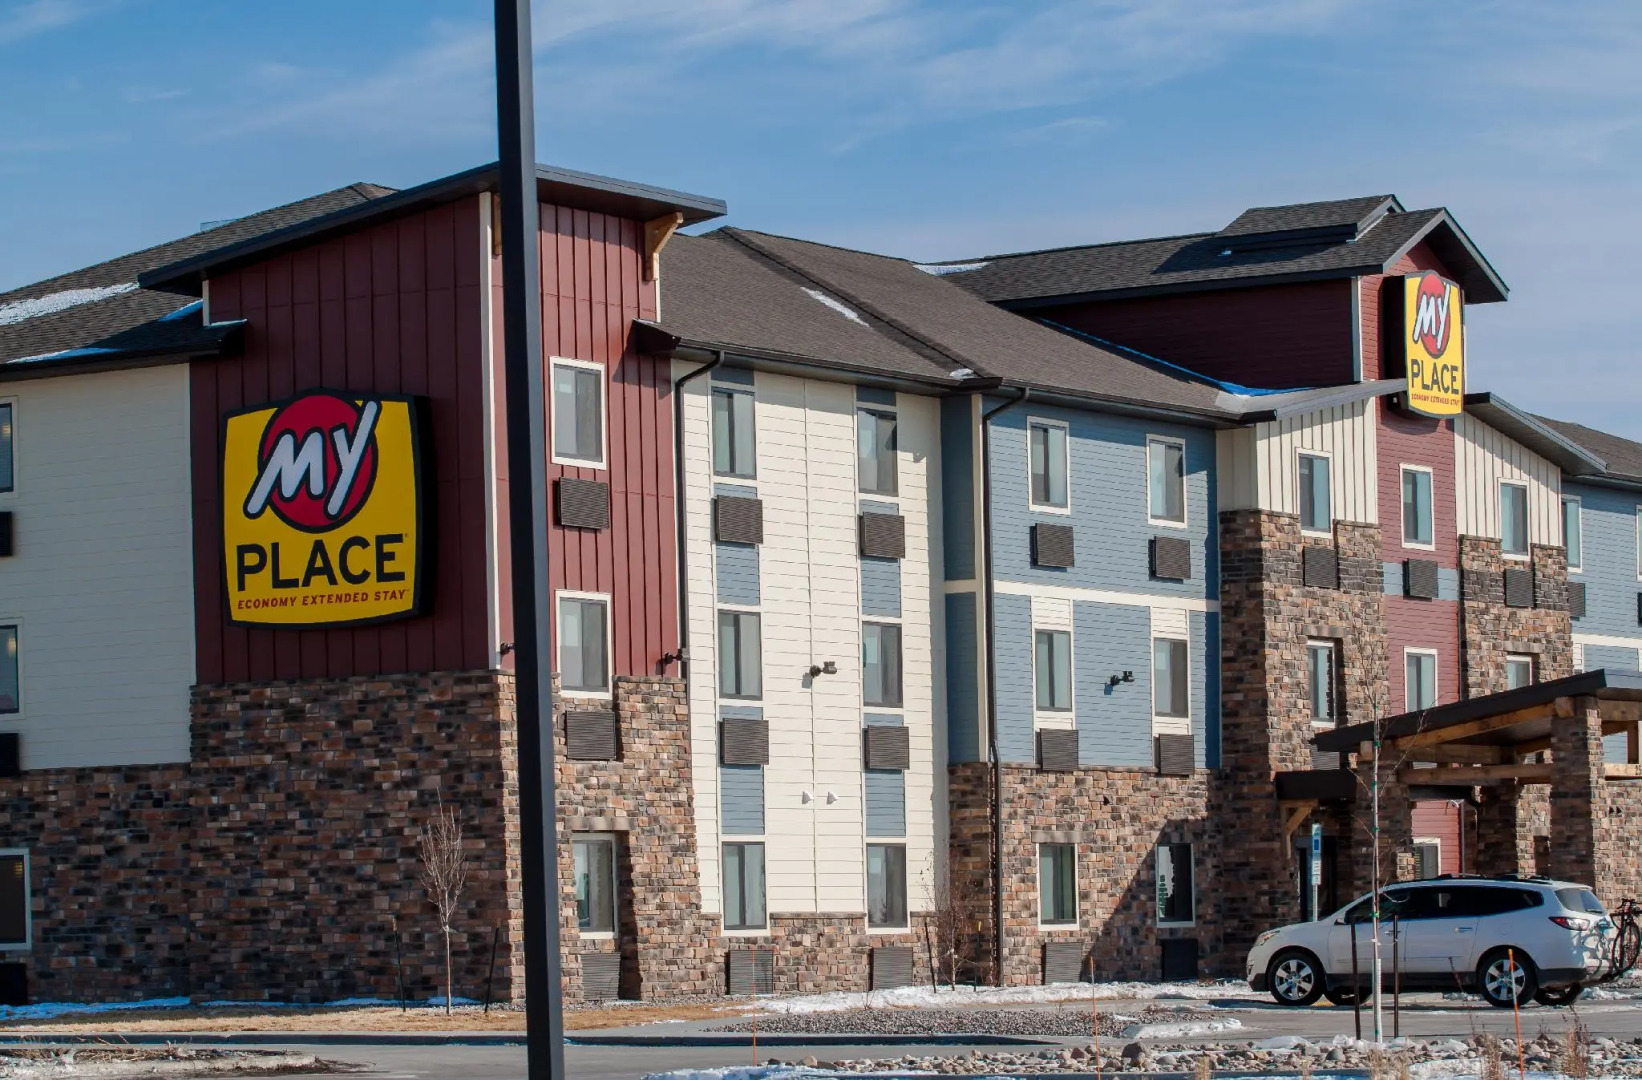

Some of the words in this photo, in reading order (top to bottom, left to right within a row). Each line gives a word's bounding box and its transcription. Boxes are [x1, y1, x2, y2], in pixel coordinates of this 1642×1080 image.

[1411, 358, 1460, 395] PLACE
[236, 533, 406, 592] PLACE
[237, 596, 297, 610] ECONOMY
[301, 592, 369, 606] EXTENDED
[374, 589, 406, 601] STAY
